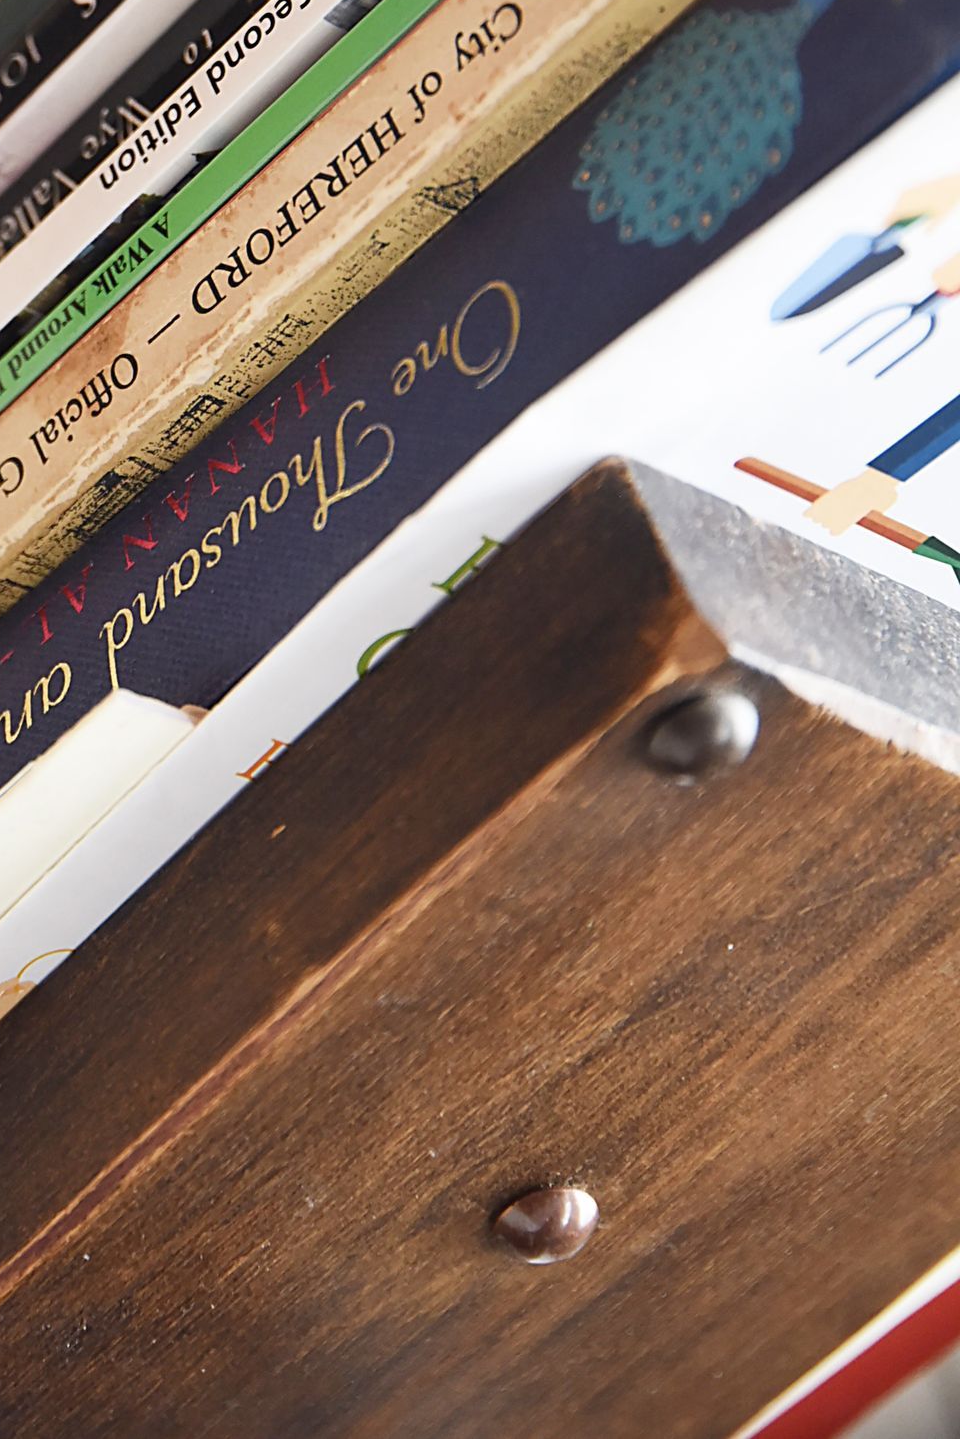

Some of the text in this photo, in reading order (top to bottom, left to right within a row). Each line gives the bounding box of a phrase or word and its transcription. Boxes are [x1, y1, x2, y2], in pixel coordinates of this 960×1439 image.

[179, 31, 215, 65] to
[402, 70, 446, 123] of
[69, 88, 150, 165] Wye
[97, 85, 203, 191] Edition
[150, 211, 172, 239] A
[188, 107, 407, 316] HEREFORD
[89, 236, 153, 296] Walk
[4, 288, 90, 380] Around
[386, 276, 530, 409] One
[28, 350, 142, 462] Official
[117, 355, 340, 571] HANAN
[90, 397, 399, 703] Thousand
